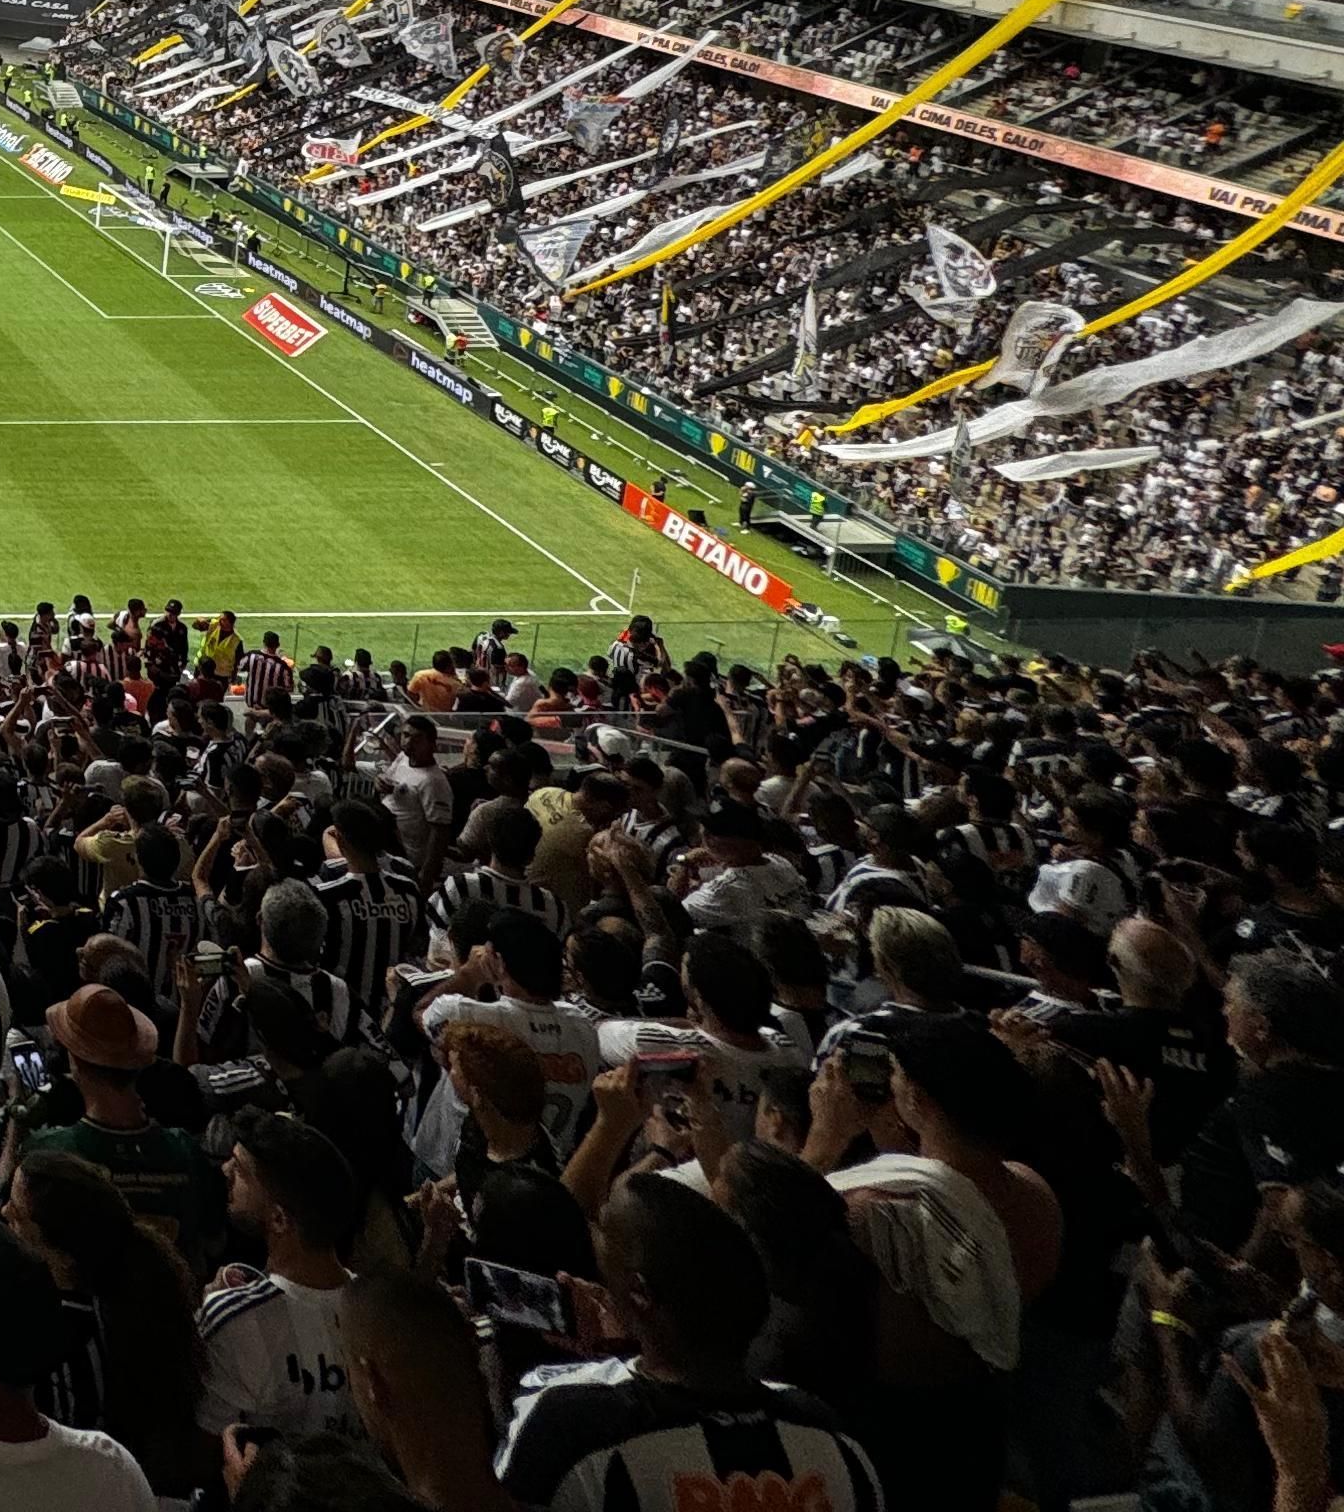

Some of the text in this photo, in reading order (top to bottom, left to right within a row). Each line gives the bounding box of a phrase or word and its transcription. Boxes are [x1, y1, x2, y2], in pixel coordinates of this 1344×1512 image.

[31, 0, 69, 11] CASA
[919, 109, 951, 129] CIMA
[954, 120, 997, 142] DELES,
[1001, 130, 1044, 152] GALO!
[1208, 187, 1235, 206] VAI
[173, 212, 214, 245] heatmap
[248, 252, 298, 293] heatmap
[254, 299, 315, 346] SUPERBET
[320, 294, 372, 339] heatmap
[411, 351, 473, 404] heatmap
[627, 392, 648, 415] FINAL
[732, 448, 757, 476] FINAL
[662, 512, 768, 596] BETANO
[966, 579, 999, 611] FINAL
[368, 899, 409, 923] bmg
